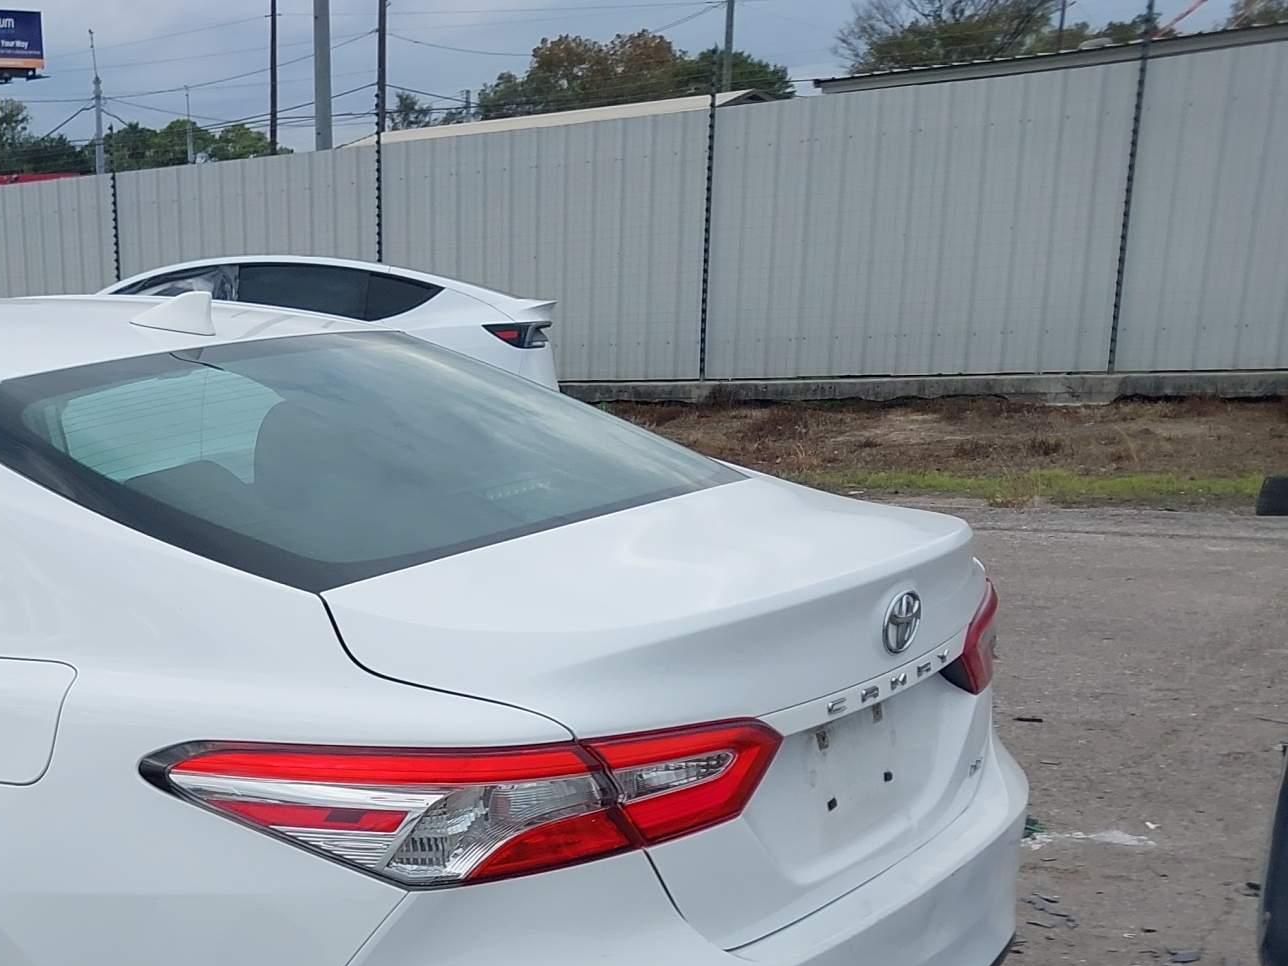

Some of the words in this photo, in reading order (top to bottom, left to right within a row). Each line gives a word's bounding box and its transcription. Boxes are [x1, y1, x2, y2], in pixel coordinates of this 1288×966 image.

[1, 40, 15, 48] Your
[15, 41, 29, 49] Way
[827, 649, 950, 714] CAMRY
